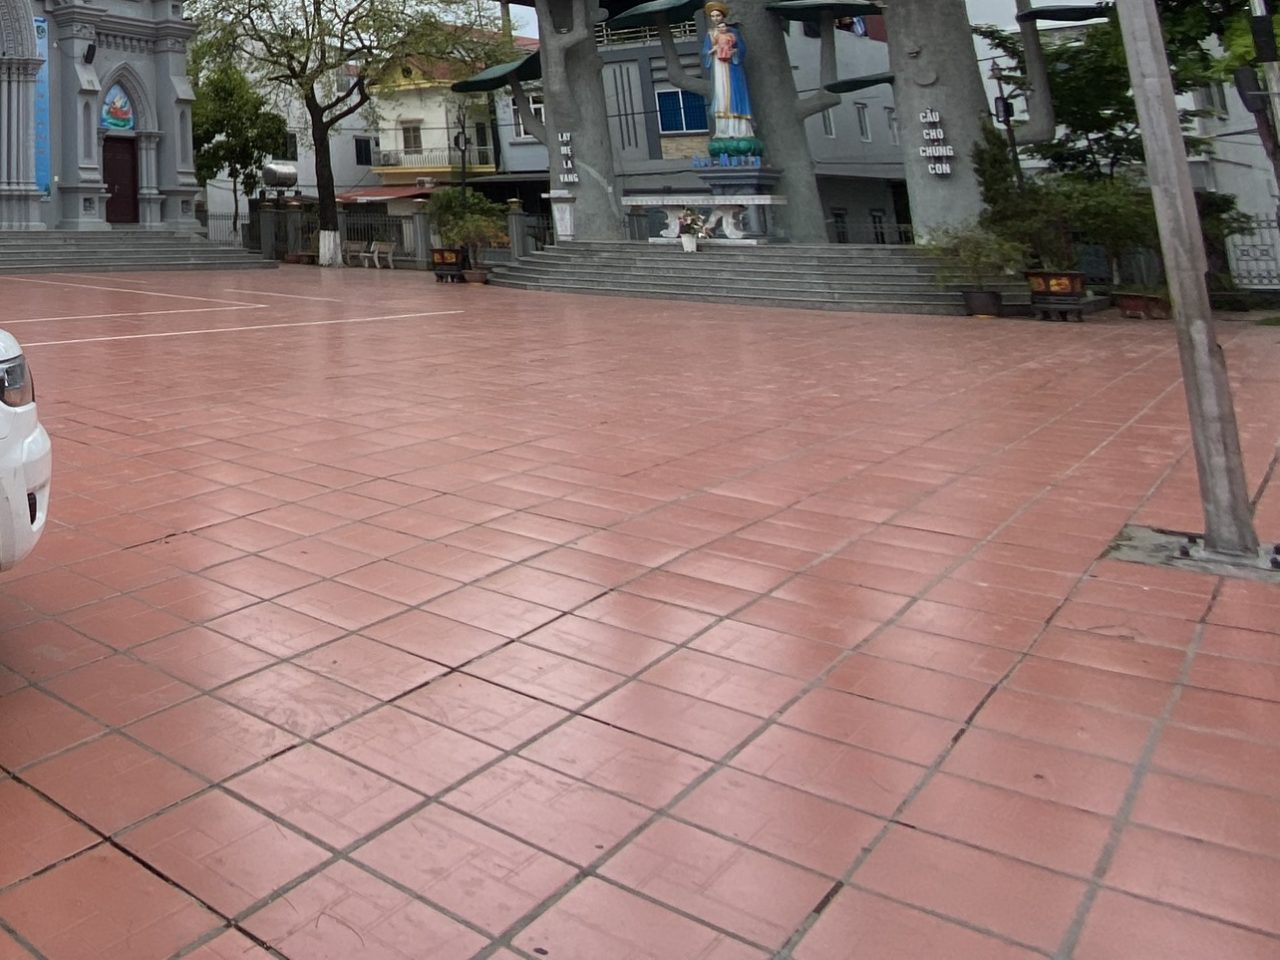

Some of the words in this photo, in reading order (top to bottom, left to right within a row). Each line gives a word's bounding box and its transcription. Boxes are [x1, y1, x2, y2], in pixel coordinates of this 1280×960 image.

[920, 105, 939, 122] CẦU
[923, 129, 944, 139] CHO
[920, 142, 954, 156] CHÚNG
[928, 164, 951, 174] CON
